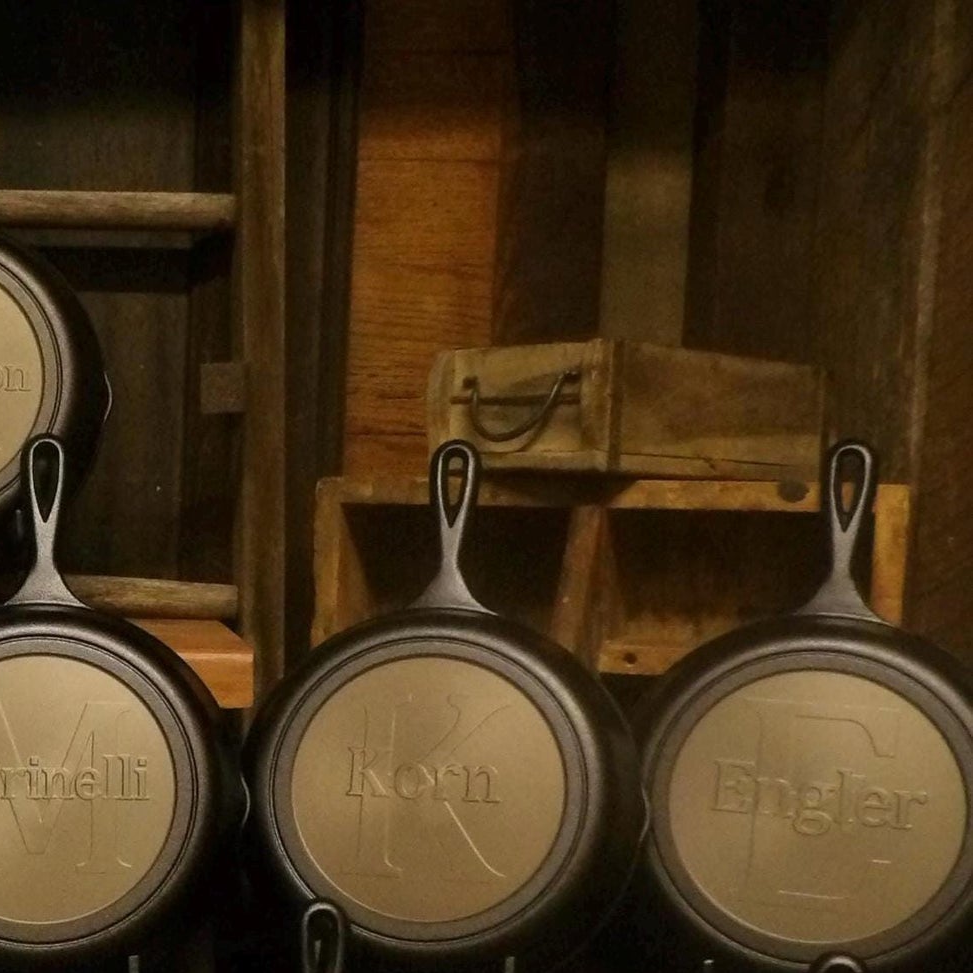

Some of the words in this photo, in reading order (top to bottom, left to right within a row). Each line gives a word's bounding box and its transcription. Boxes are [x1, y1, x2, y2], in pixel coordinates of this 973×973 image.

[339, 693, 513, 884] K
[345, 746, 501, 804] Korn
[711, 759, 928, 837] Engler
[732, 697, 901, 912] E
